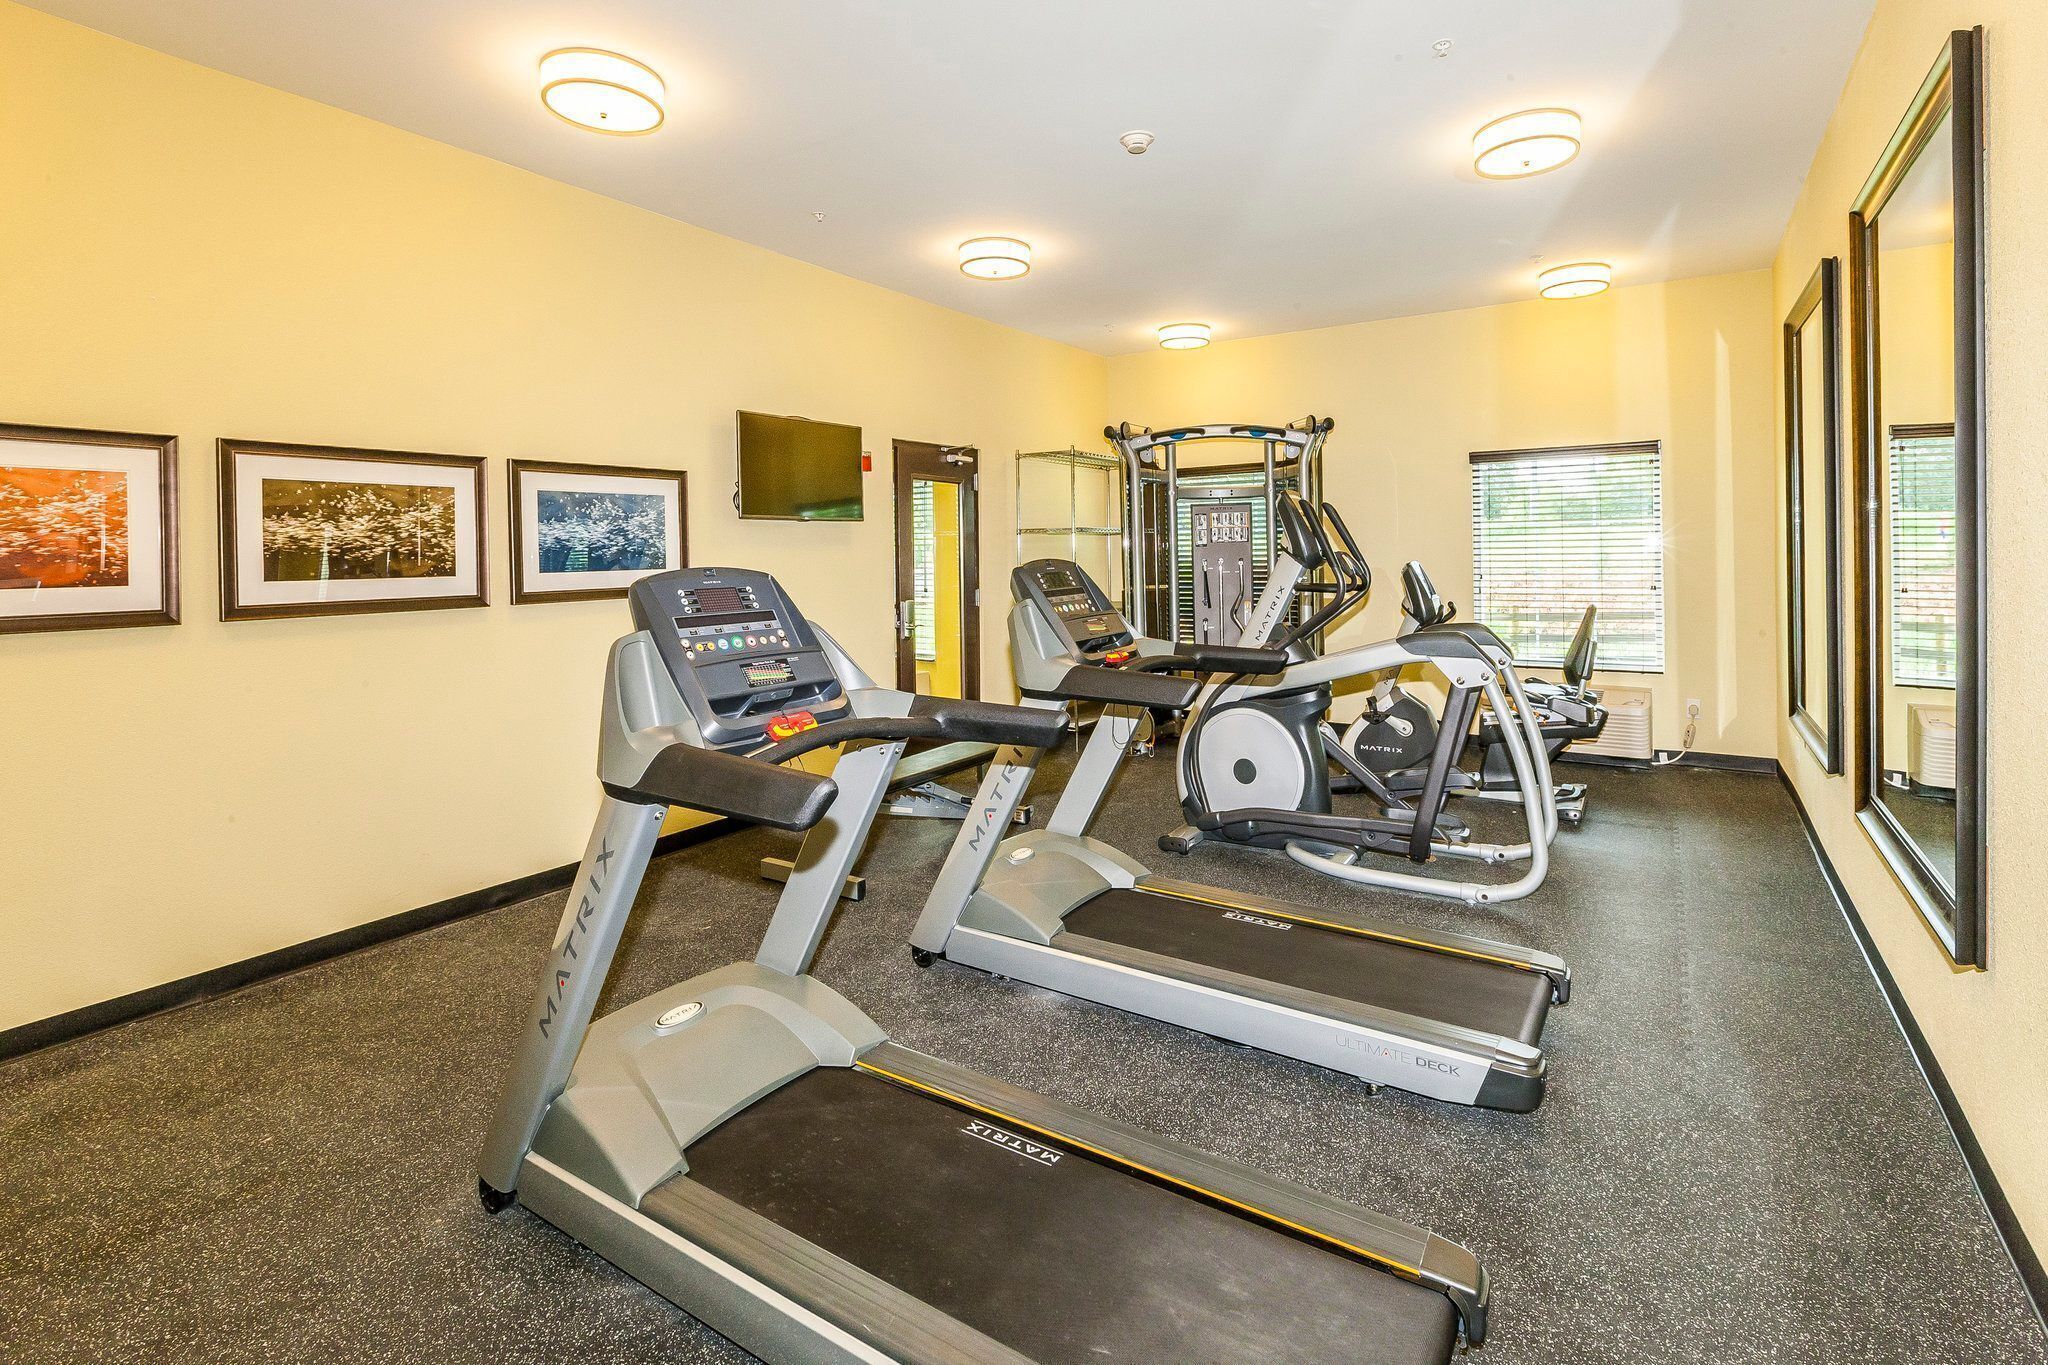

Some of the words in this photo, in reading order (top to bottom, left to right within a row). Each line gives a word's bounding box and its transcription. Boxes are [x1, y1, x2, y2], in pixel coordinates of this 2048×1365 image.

[1255, 586, 1285, 641] MATRIX
[1360, 744, 1403, 754] MATRIX
[969, 747, 1023, 852] MATRI
[539, 837, 615, 1039] MATRIX
[1335, 1034, 1411, 1065] ULTIMATE
[1415, 1056, 1460, 1077] DECK
[966, 1122, 1061, 1163] MATRIX
